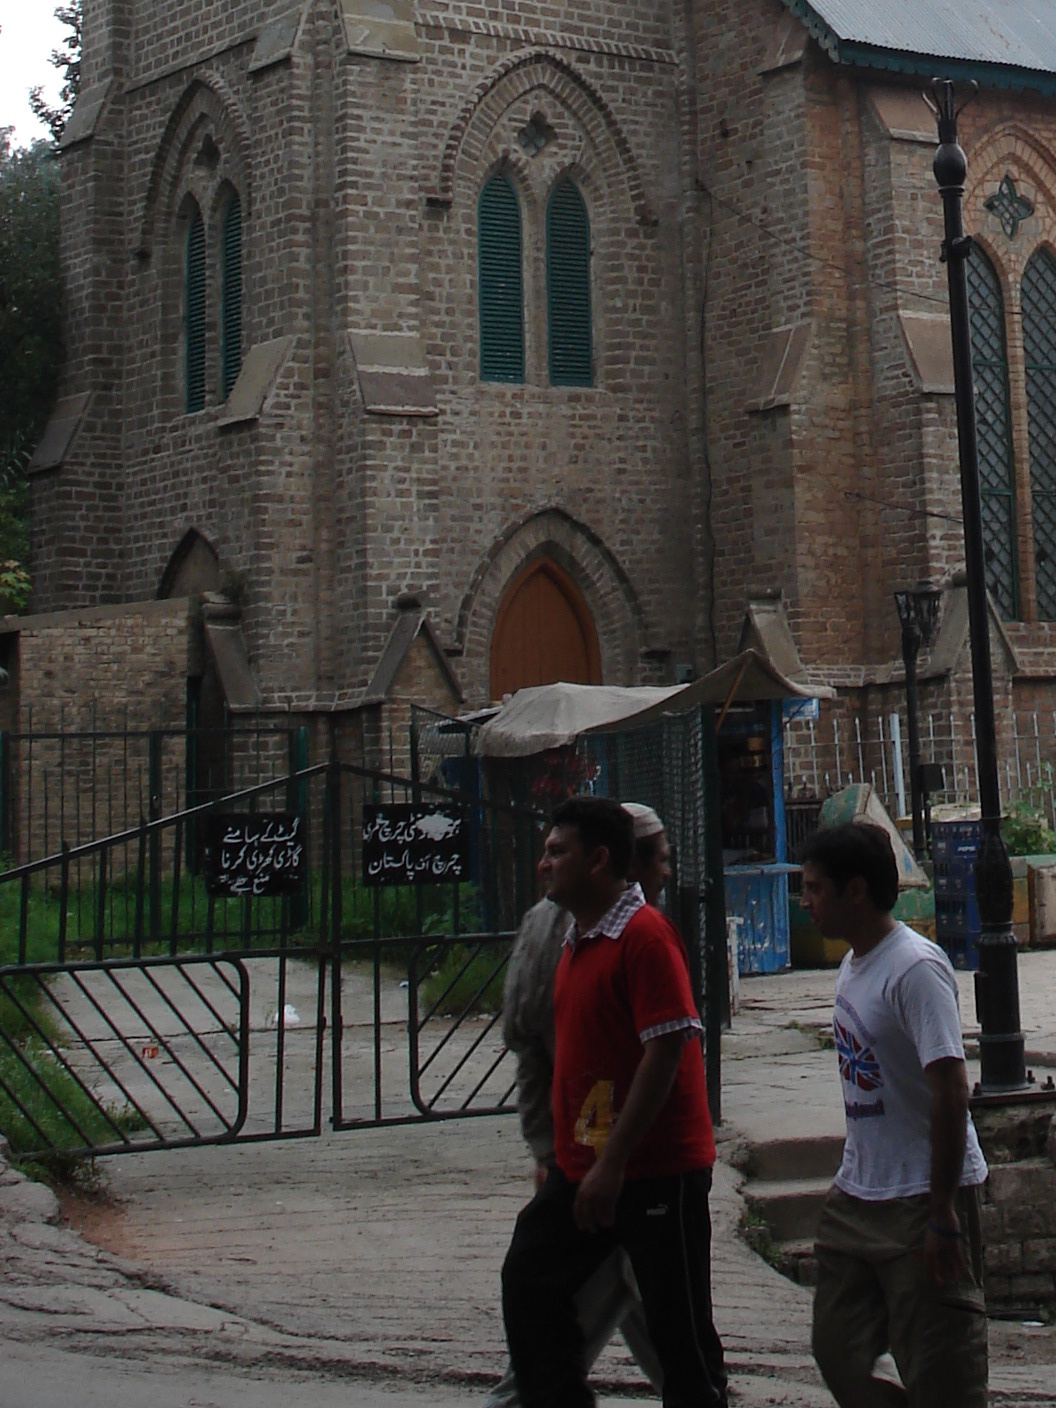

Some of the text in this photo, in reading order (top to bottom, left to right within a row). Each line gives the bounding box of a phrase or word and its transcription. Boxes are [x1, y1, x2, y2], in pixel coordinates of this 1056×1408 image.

[223, 817, 301, 846] گیٹ کے سامنے
[378, 819, 406, 845] چرچ
[222, 844, 303, 875] گاڑی کھڑی کرنا
[368, 848, 415, 881] پاکستان
[432, 853, 462, 875] چرچ
[253, 873, 270, 894] منع
[574, 1080, 621, 1160] 4
